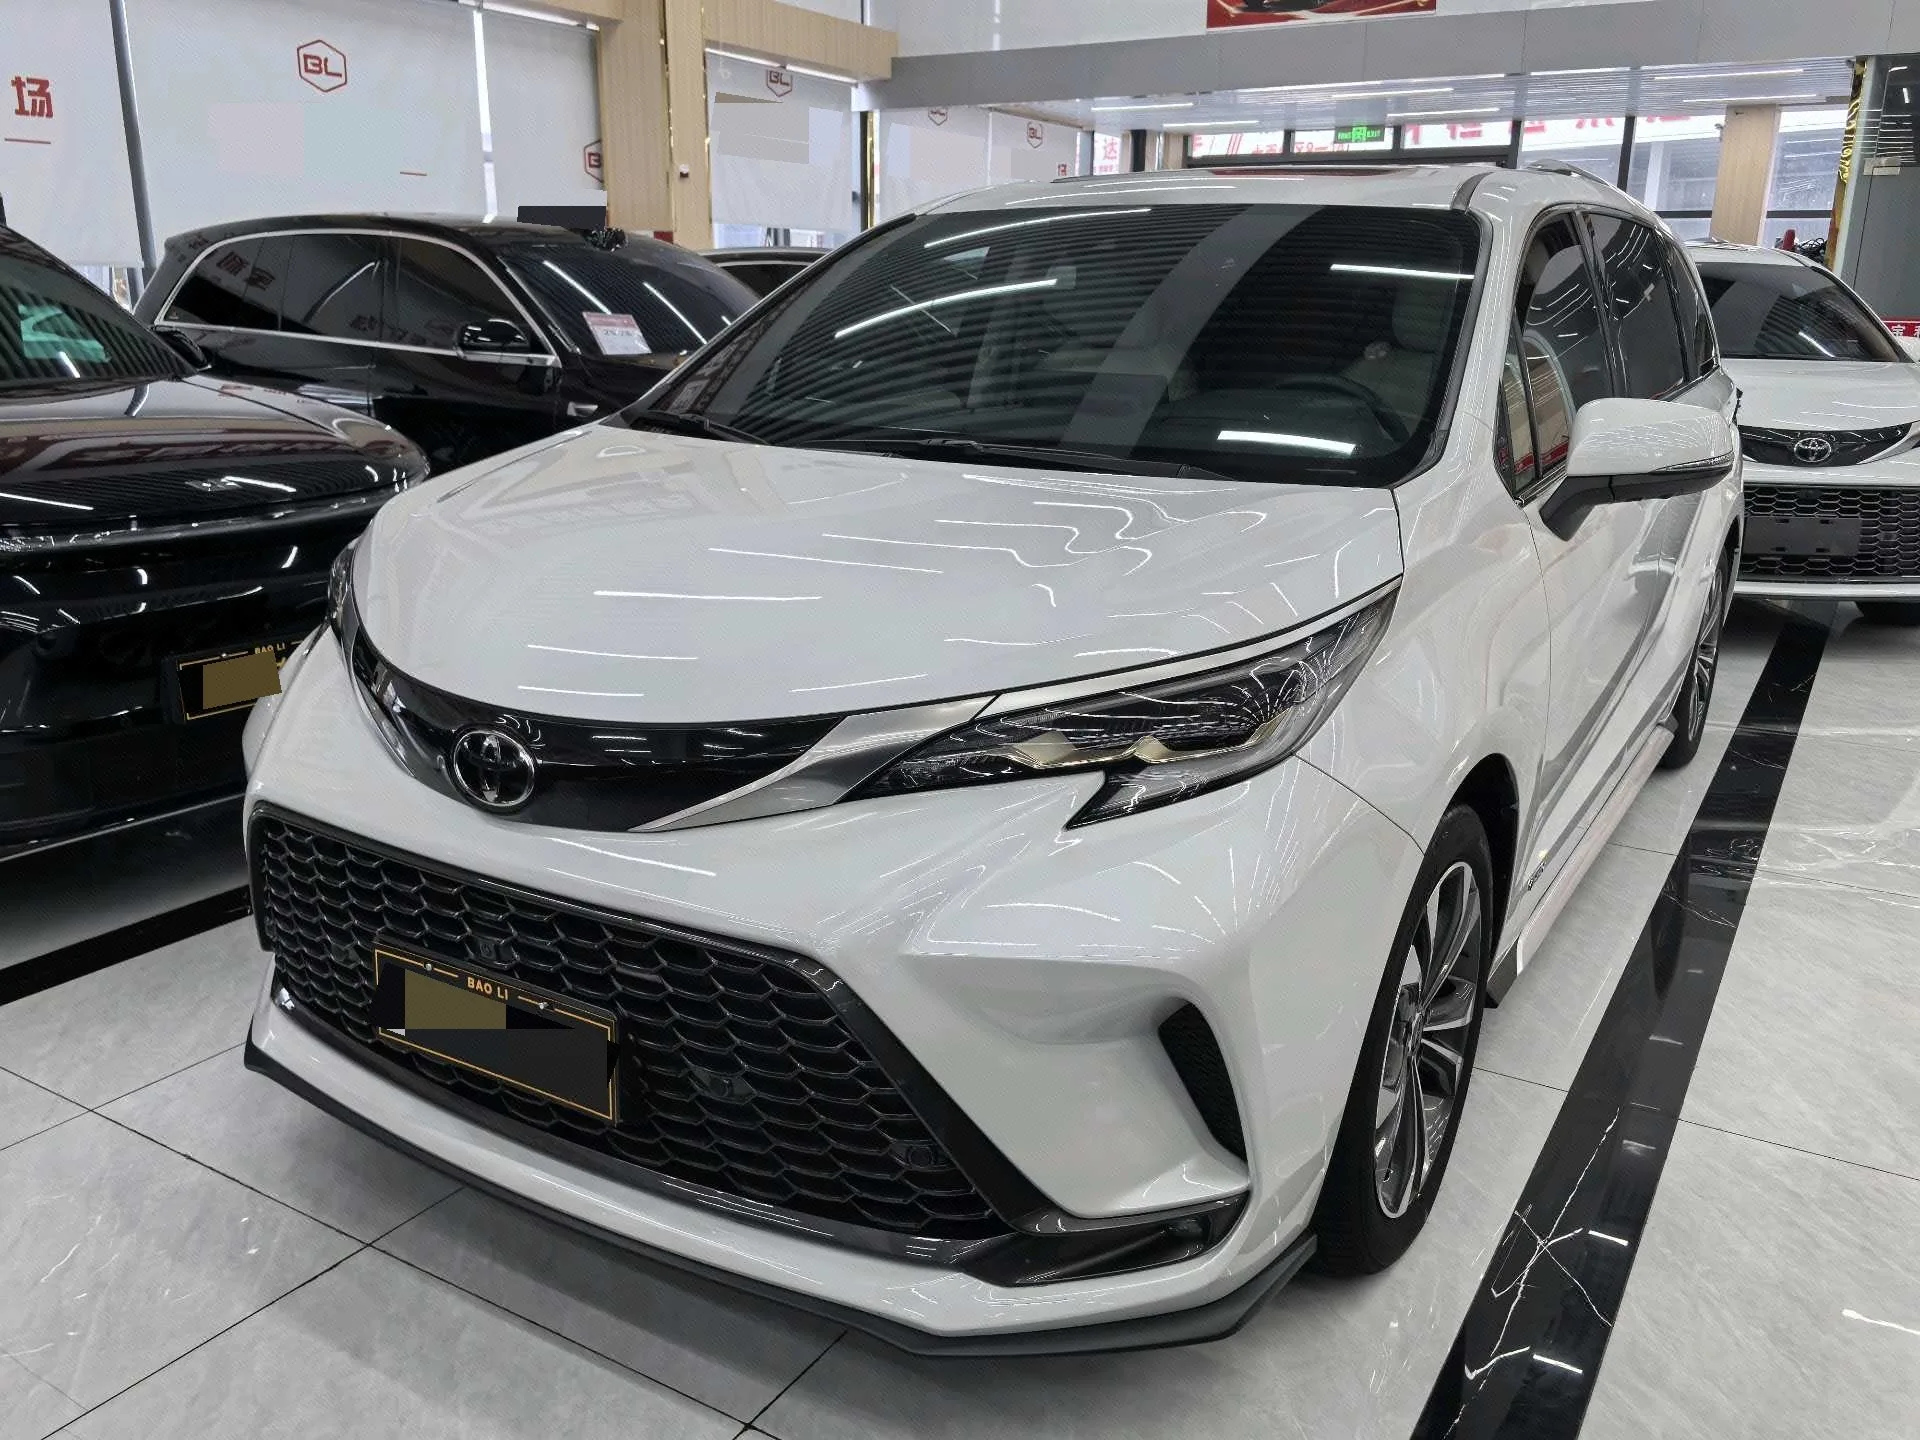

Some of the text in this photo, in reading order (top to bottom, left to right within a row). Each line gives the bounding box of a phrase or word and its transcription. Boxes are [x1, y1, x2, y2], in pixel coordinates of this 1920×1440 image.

[303, 53, 343, 78] BL
[769, 70, 790, 87] BL
[11, 76, 54, 119] 场
[254, 641, 286, 655] BAO LI
[467, 976, 509, 1001] BAO LI
